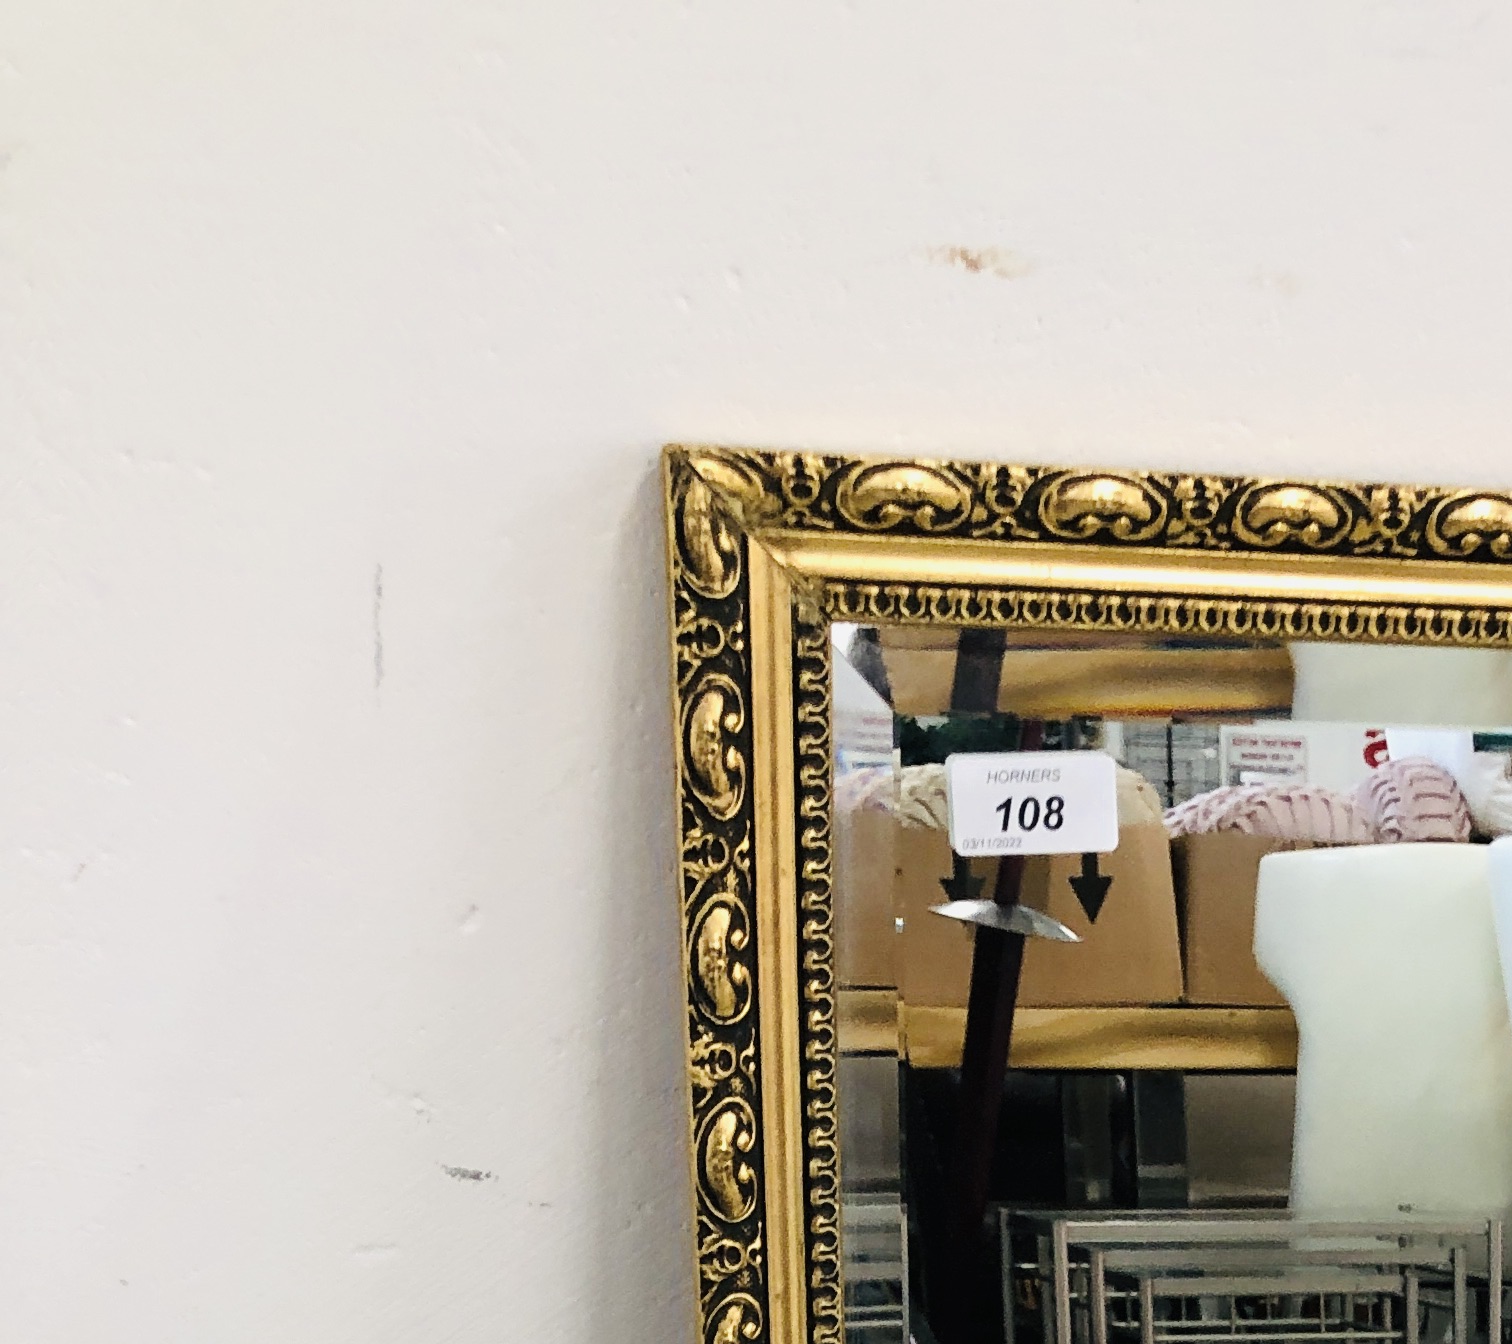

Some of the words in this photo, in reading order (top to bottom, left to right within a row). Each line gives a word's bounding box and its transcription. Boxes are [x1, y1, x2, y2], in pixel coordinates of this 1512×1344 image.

[986, 768, 1061, 784] HORNERS
[995, 796, 1065, 833] 108
[962, 837, 1023, 851] 03/11/2022
